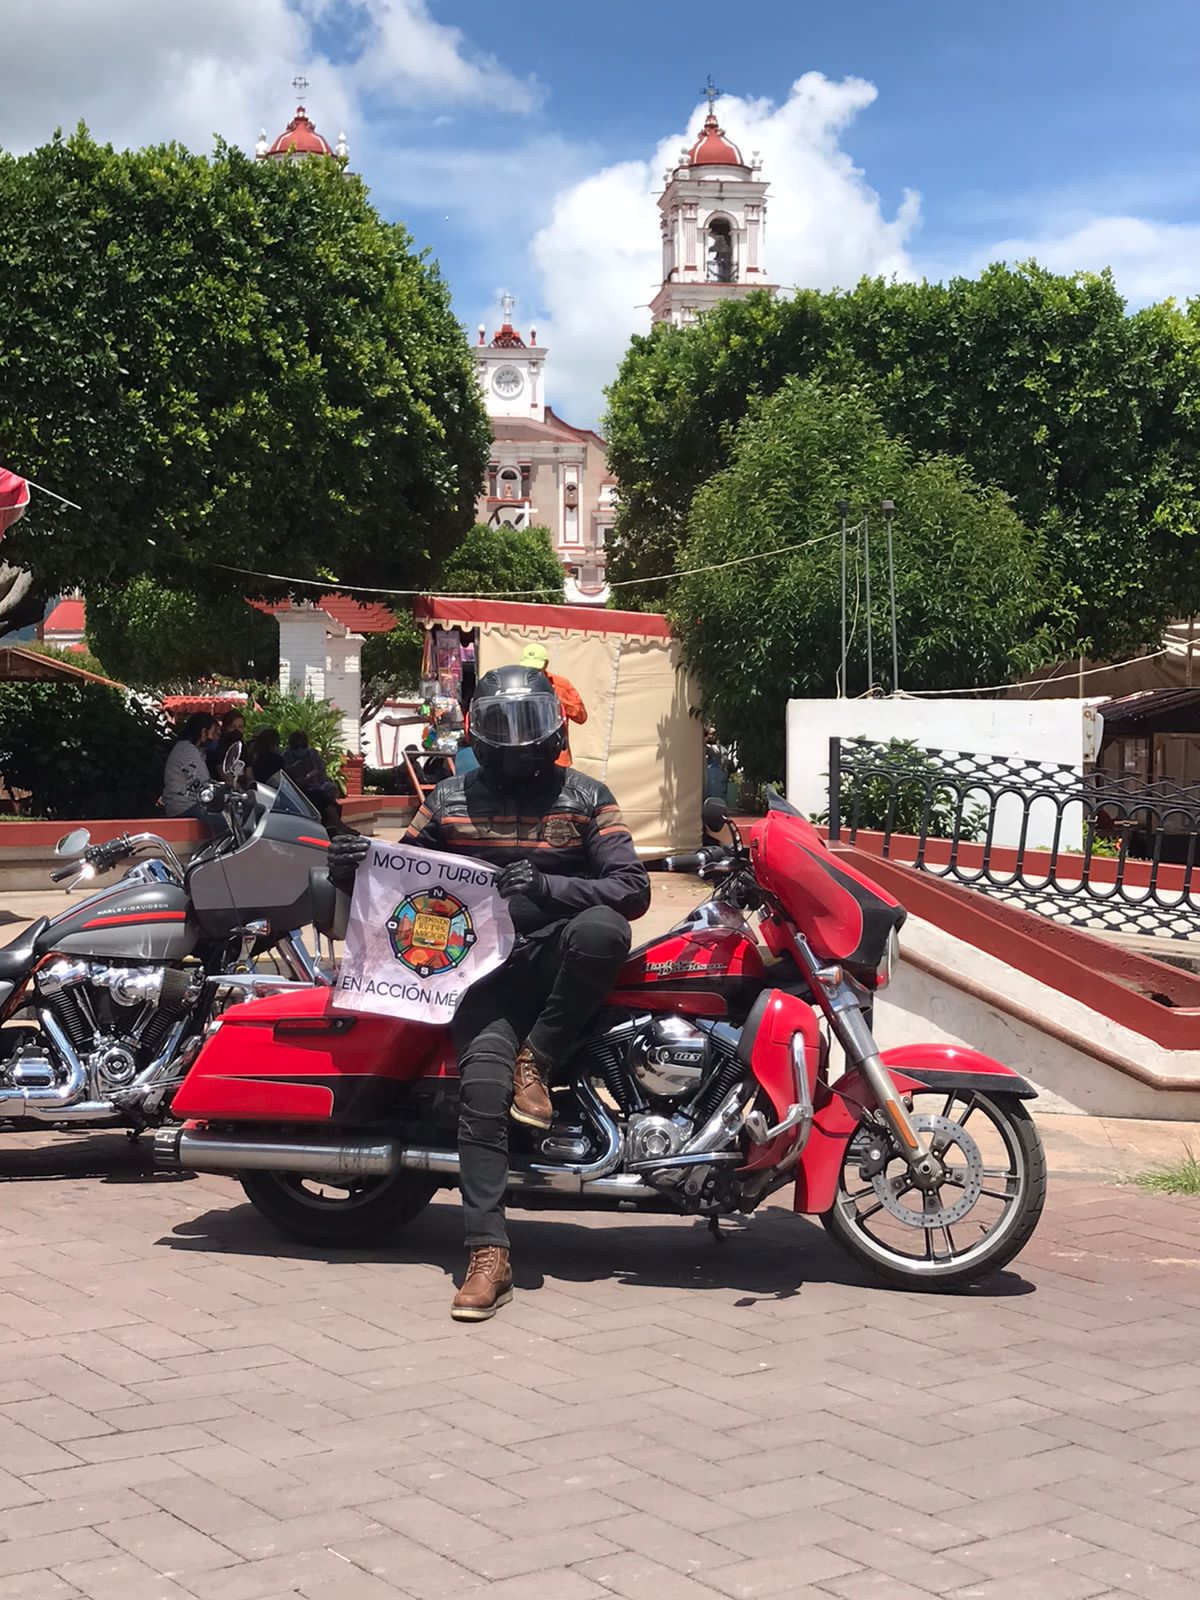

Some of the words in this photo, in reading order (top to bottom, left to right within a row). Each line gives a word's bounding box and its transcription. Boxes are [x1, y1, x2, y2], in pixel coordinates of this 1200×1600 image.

[373, 851, 432, 876] MOTO
[433, 889, 443, 897] N
[342, 975, 362, 991] EN
[365, 979, 431, 1003] ACCIÓN
